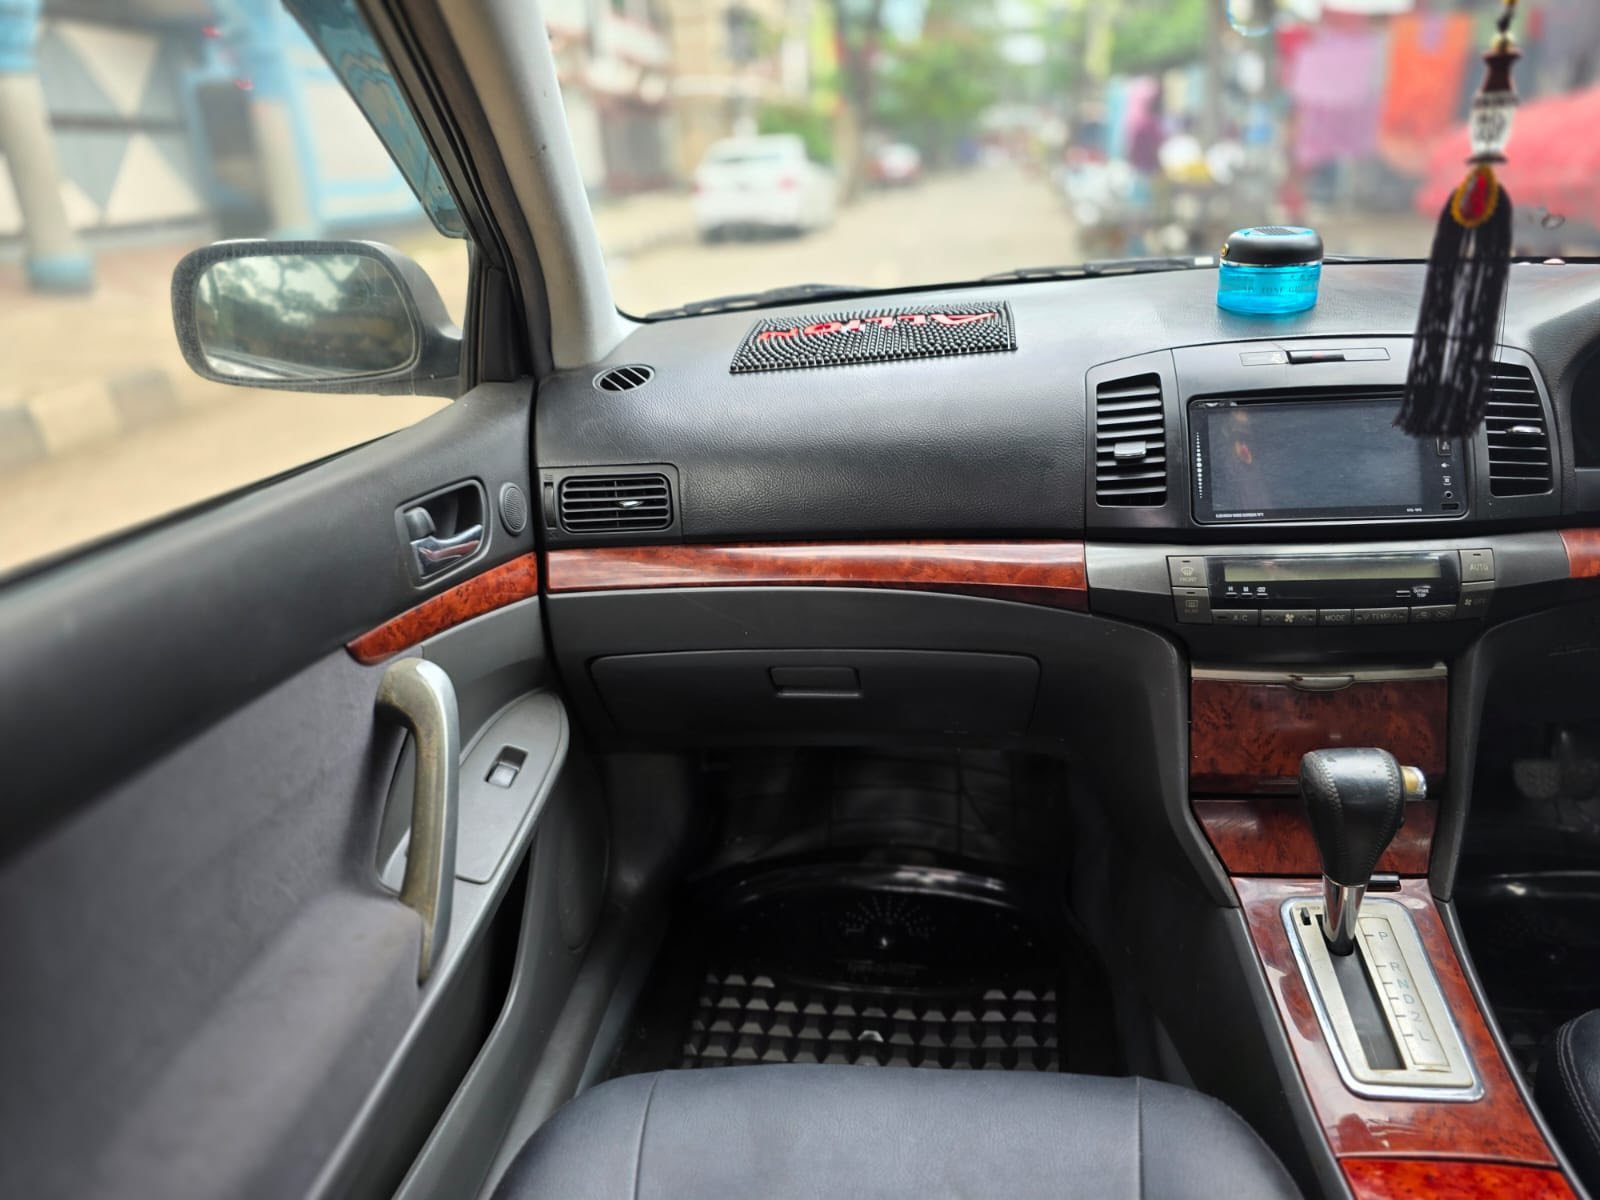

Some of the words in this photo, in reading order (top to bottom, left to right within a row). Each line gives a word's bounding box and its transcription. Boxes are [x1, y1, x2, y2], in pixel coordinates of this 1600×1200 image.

[758, 311, 996, 341] ALLION
[1469, 563, 1489, 571] AUTO
[1324, 614, 1345, 622] MODE
[1378, 931, 1388, 940] P
[1390, 961, 1400, 971] R
[1396, 979, 1410, 989] N
[1403, 994, 1415, 1004] D
[1411, 1011, 1424, 1022] 2
[1418, 1031, 1431, 1042] L
